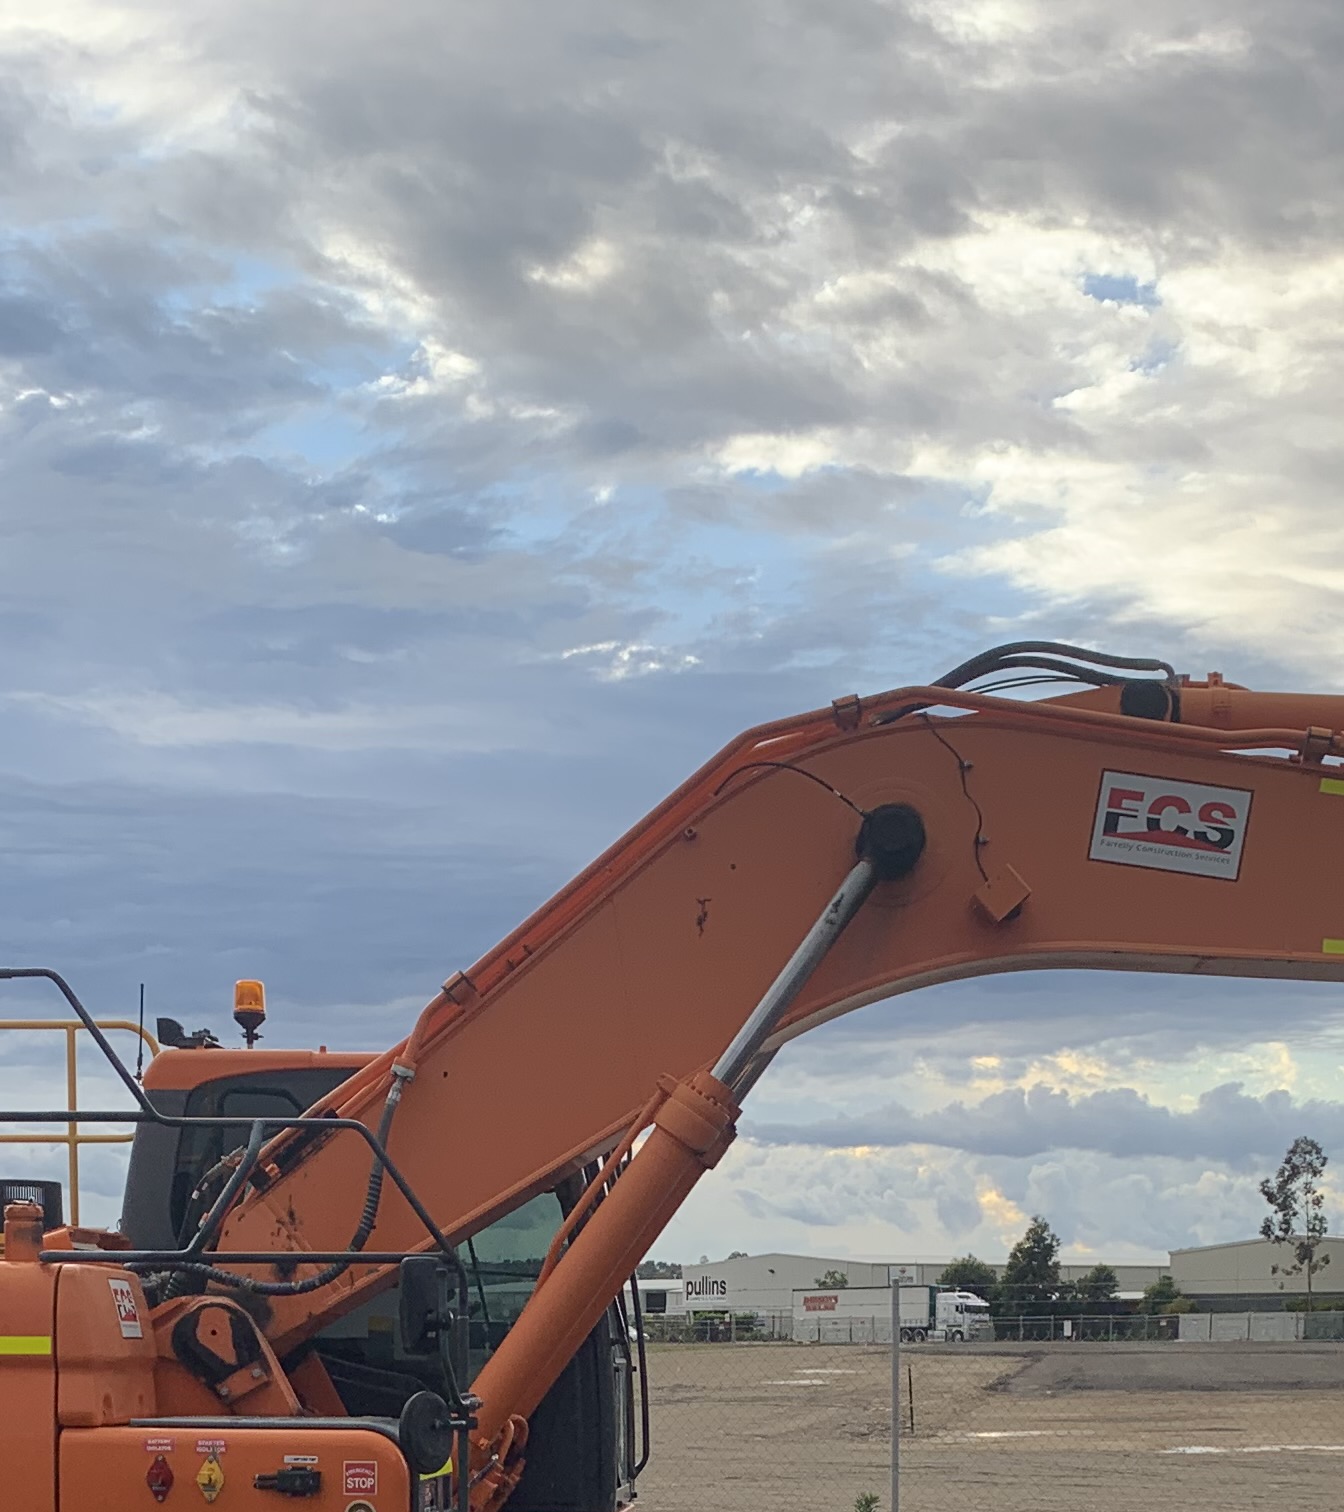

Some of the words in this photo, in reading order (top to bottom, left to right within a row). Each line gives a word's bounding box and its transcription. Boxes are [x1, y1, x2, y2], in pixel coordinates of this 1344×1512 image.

[1102, 787, 1237, 850] FCS
[1100, 838, 1134, 851] Farrelly
[1136, 844, 1193, 859] Construction
[1195, 852, 1231, 865] Services
[686, 1275, 726, 1301] pullins
[346, 1477, 375, 1489] STOP
